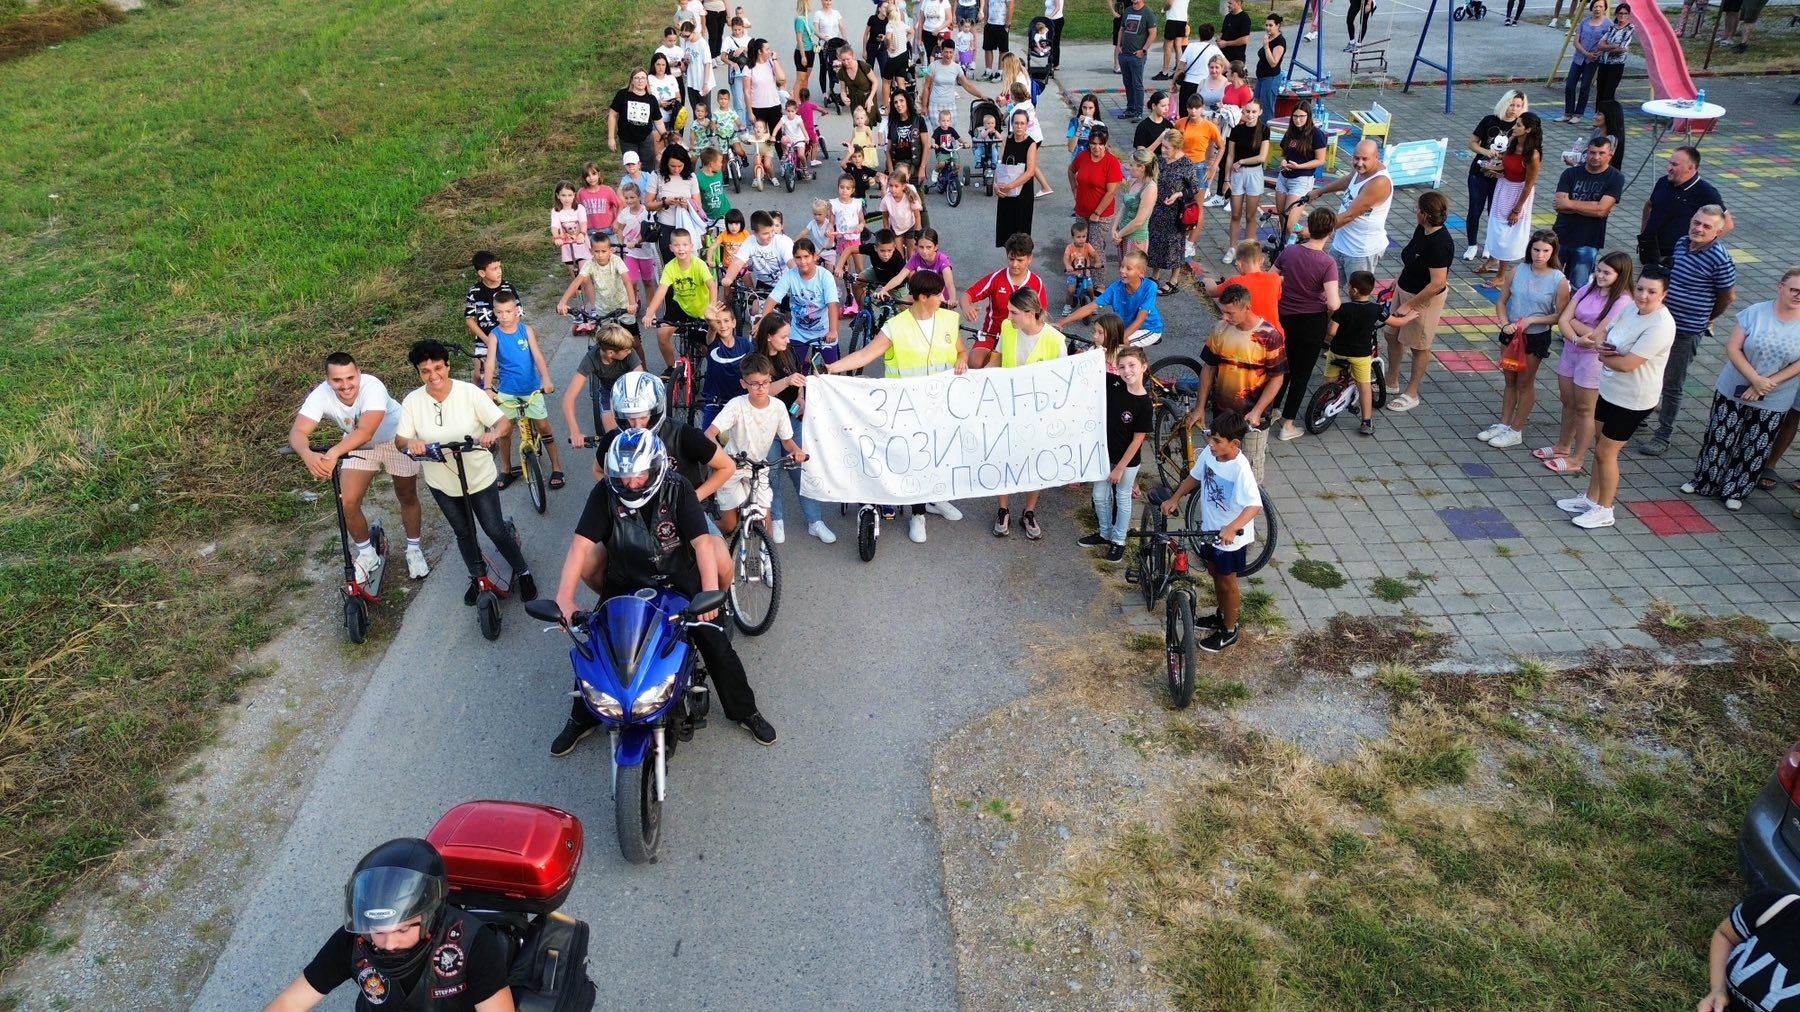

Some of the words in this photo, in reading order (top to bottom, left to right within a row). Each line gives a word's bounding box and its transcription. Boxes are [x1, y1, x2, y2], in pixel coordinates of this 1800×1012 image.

[868, 387, 922, 429] ЗА
[946, 367, 1075, 420] САЊУ
[859, 424, 963, 478] ВОЗИ
[983, 423, 1011, 461] И
[951, 440, 1103, 496] ПОМОЗИ
[434, 986, 458, 997] STEFAN
